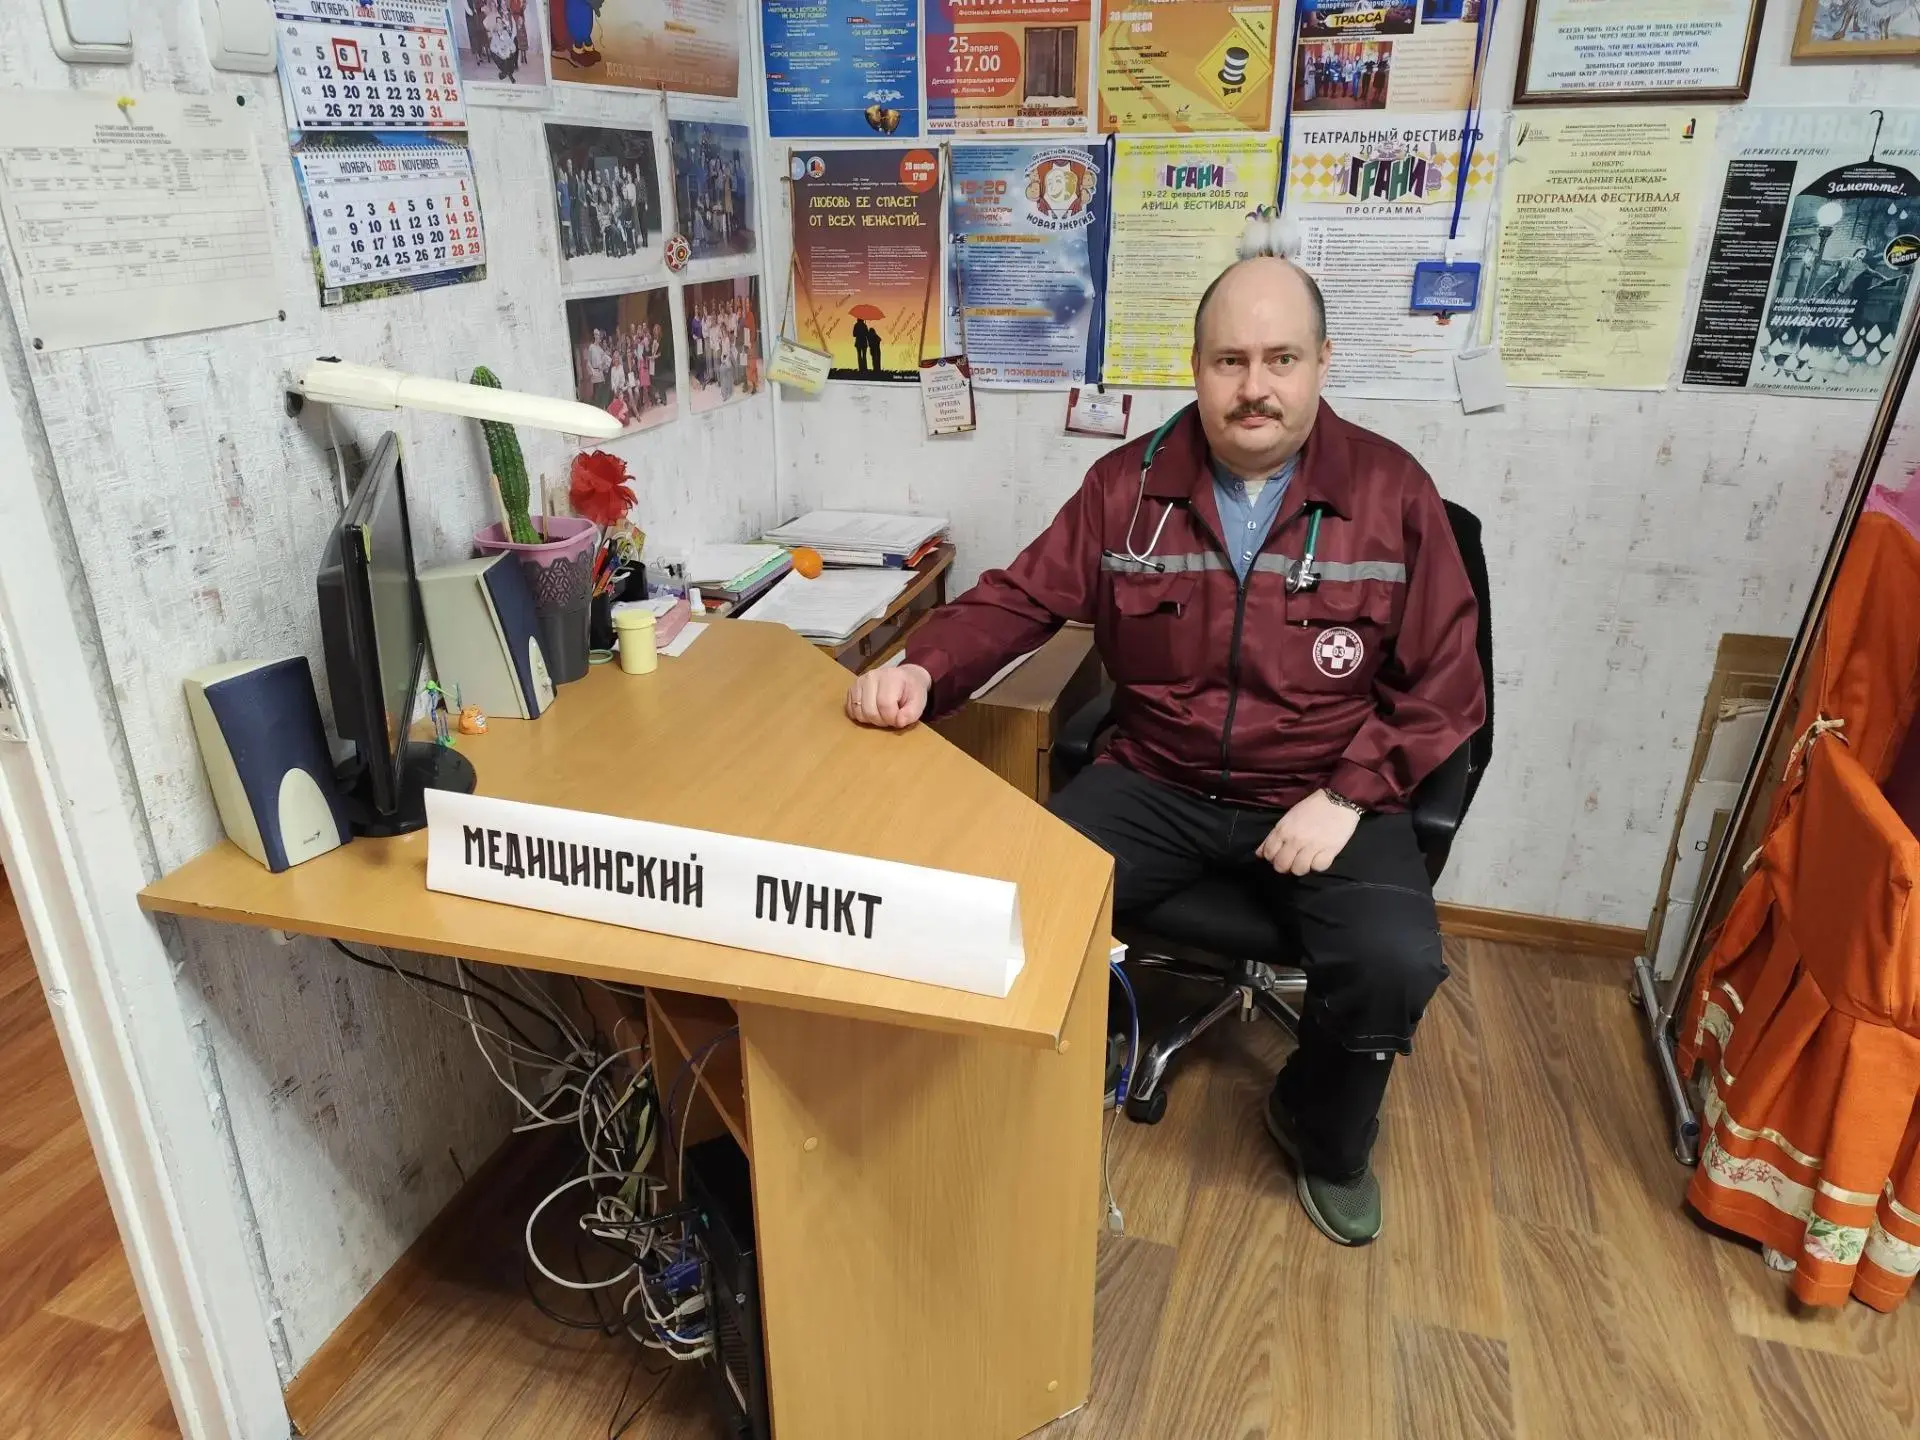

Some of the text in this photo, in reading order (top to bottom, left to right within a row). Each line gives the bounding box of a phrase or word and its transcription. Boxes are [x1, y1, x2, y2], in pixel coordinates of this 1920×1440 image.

[311, 1, 349, 17] ОКТЯБРЬ
[381, 9, 416, 24] OCTOBER
[1052, 6, 1069, 14] форм
[1334, 12, 1382, 25] ТРАССА
[378, 33, 444, 51] 1 2 3 4
[948, 37, 998, 53] 25 апреля
[316, 46, 449, 68] 5 6 7 8 9 10 11
[954, 55, 1001, 72] 17.00
[317, 66, 454, 85] 12 13 14 15 16 17 18
[931, 78, 955, 86] Детская
[321, 85, 337, 98] 19
[343, 85, 360, 99] 20
[366, 86, 380, 99] 21
[386, 87, 402, 100] 22
[406, 88, 421, 101] 23
[425, 88, 440, 101] 24
[444, 89, 458, 101] 25
[325, 104, 342, 117] 26
[348, 104, 363, 117] 27
[369, 104, 385, 118] 28
[390, 105, 405, 118] 29
[410, 105, 424, 118] 30
[430, 105, 443, 118] 31
[1017, 109, 1084, 117] Вход свободный
[929, 119, 1006, 129] www.trassafest.ru
[1304, 128, 1398, 144] ТЕАТРАЛЬНЫЙ
[1032, 149, 1093, 161] ОБЛАСТНОЙ КОНКУРС
[339, 158, 440, 173] НОЯБРЬ 2026 NOVEMBER
[1166, 164, 1224, 190] ГРАНИ
[1349, 156, 1427, 201] ГРАНИ
[1546, 176, 1667, 185] «ТЕАТРАЛЬНЫЕ НАДЕЖДЫ»
[460, 179, 466, 192] 1
[1828, 181, 1907, 197] Заметьте!..
[809, 196, 919, 208] ЛЮБОВЬ ЕЕ СПАСЕТ
[1171, 191, 1206, 200] февраля
[1210, 189, 1231, 198] 2015
[1235, 191, 1248, 199] год
[1516, 192, 1680, 204] ПРОГРАММА ФЕСТИВАЛЯ
[345, 204, 355, 218] 2
[367, 203, 376, 216] 3
[387, 201, 397, 214] 4
[407, 200, 416, 212] 5
[426, 198, 434, 211] 6
[444, 197, 451, 209] 7
[462, 195, 470, 207] 8
[1141, 200, 1246, 210] АФИША ФЕСТИВАЛЯ
[349, 211, 475, 235] 9 10 11 12 13 14 15
[809, 215, 823, 226] ОТ
[829, 215, 856, 226] ВСЕХ
[1026, 213, 1094, 230] НОВАЯ ЭНЕРГИЯ
[350, 240, 365, 253] 16
[372, 238, 385, 251] 17
[392, 235, 406, 249] 18
[411, 233, 425, 246] 19
[429, 230, 444, 243] 20
[449, 228, 461, 241] 21
[465, 227, 478, 239] 22
[374, 241, 481, 268] 24 25 26 27 28 29
[1770, 316, 1851, 328] #НАВЫСОТЕ
[969, 368, 997, 376] ДОБРО
[1333, 647, 1345, 657] 03
[463, 824, 883, 940] МЕДИЦИНСКИЙ ПУНКТ
